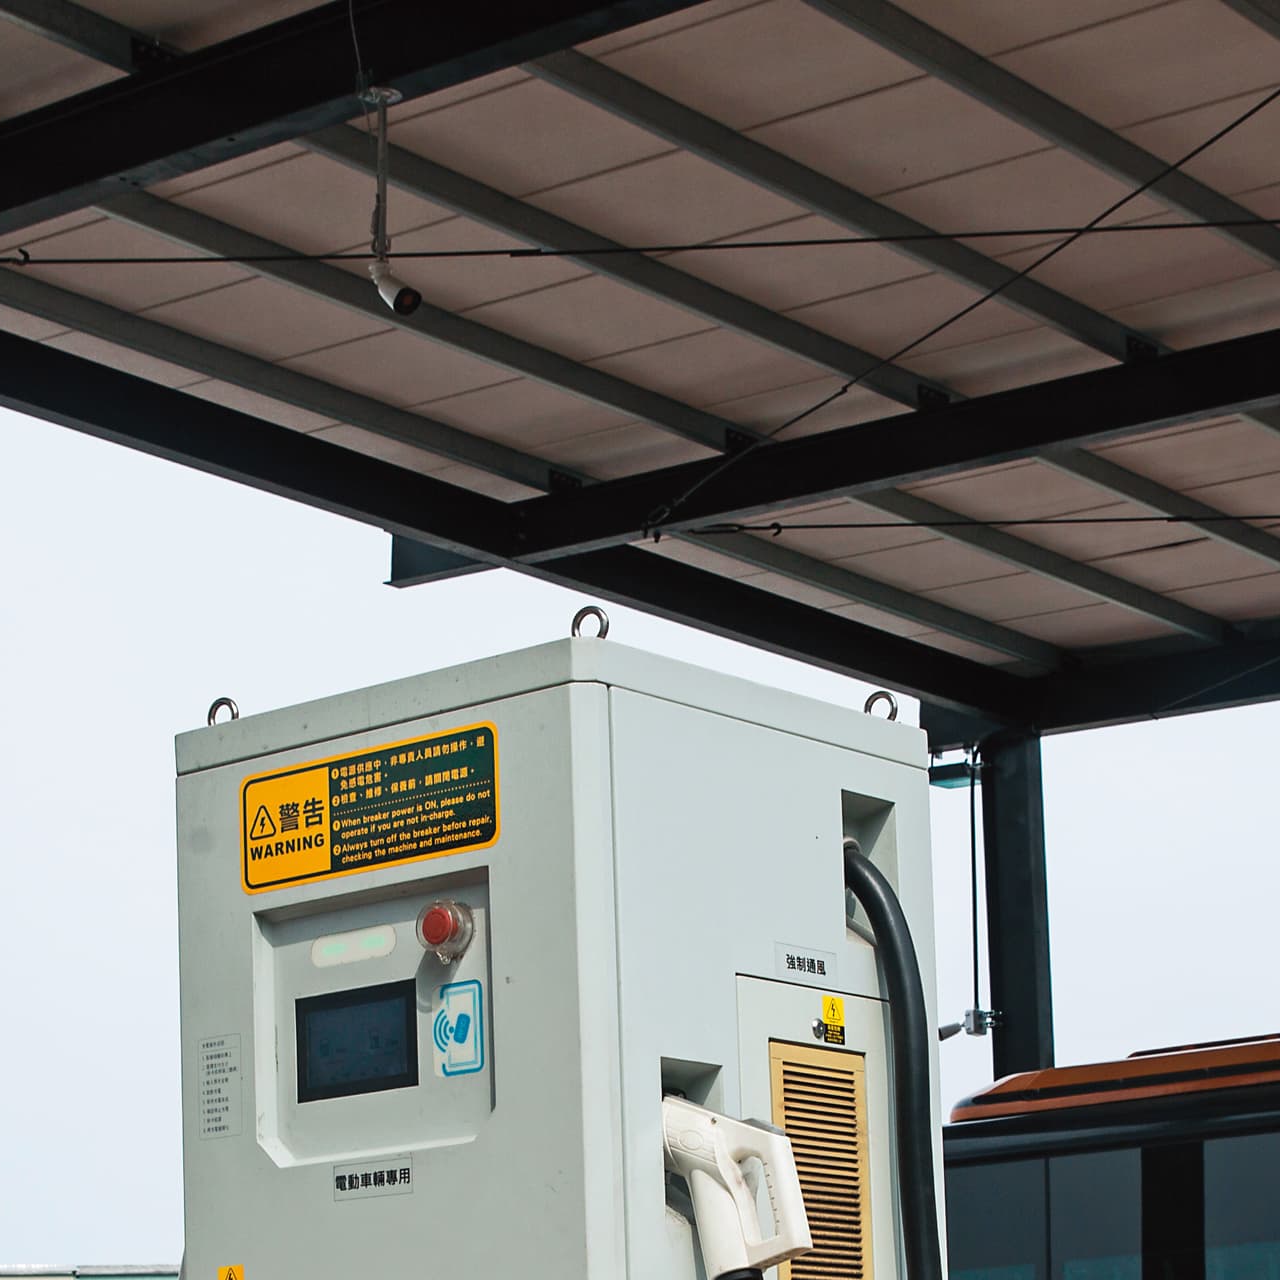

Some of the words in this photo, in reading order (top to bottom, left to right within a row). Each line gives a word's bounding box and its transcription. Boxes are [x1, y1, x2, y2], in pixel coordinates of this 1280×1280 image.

[279, 797, 325, 833] 警告
[341, 817, 361, 828] When
[362, 811, 390, 824] breaker
[391, 806, 415, 819] power
[416, 803, 423, 812] is
[440, 796, 464, 809] please
[465, 792, 476, 802] do
[477, 789, 491, 800] not
[341, 827, 369, 840] operate
[370, 824, 376, 833] if
[377, 822, 391, 833] you
[392, 819, 405, 829] are
[406, 815, 419, 826] not
[421, 809, 456, 823] in-charge.
[250, 833, 325, 861] WARNING
[341, 841, 369, 854] Always
[369, 838, 385, 848] turn
[386, 833, 397, 844] off
[399, 831, 411, 841] the
[412, 826, 441, 838] breaker
[442, 821, 467, 832] before
[341, 850, 373, 864] checking
[374, 847, 386, 857] the
[388, 842, 418, 855] machine
[419, 837, 433, 848] and
[434, 829, 483, 845] maintenance.
[786, 953, 826, 976] 強制通風
[335, 1167, 411, 1191] 電動車輛專用
